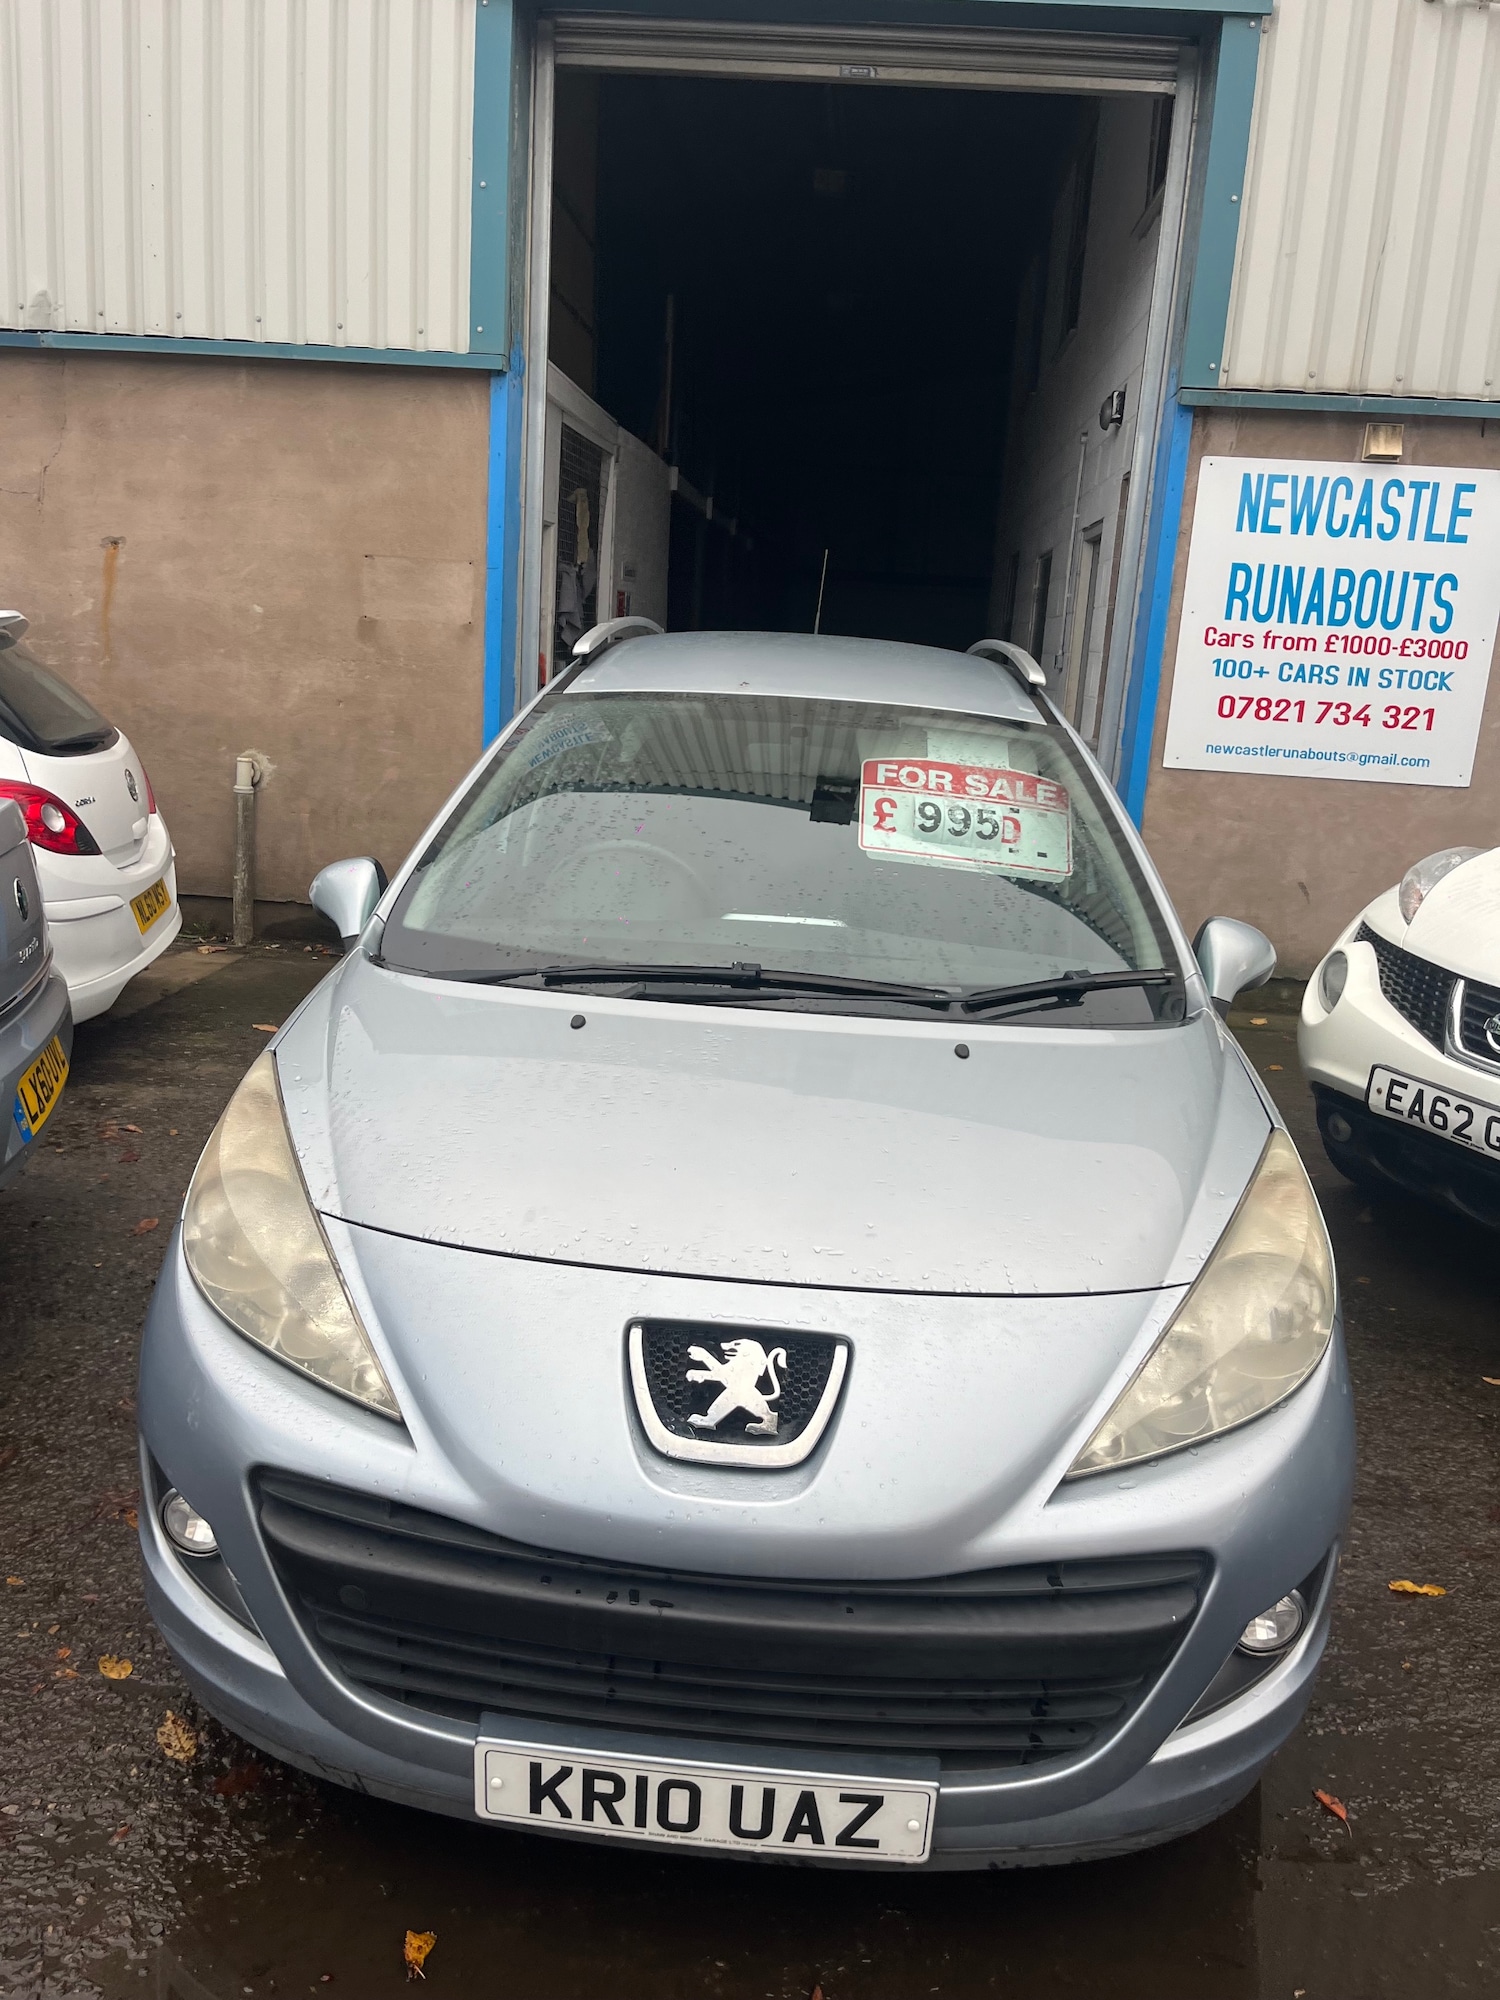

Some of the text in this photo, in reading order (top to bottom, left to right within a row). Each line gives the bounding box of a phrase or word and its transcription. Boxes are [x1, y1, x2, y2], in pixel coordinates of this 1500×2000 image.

[1236, 473, 1476, 544] NEWCASTLE
[1224, 562, 1459, 634] RUNABOUTS
[1204, 626, 1468, 660] Cars from £1000-£3000
[1212, 658, 1454, 691] 100+ CARS IN STOCK
[1217, 695, 1435, 731] 07821 734 321
[1206, 743, 1430, 768] newcastlerunabouts@gmail.com
[876, 763, 1058, 806] FOR SALE
[873, 797, 897, 833] £
[918, 801, 1000, 840] 995
[1385, 1078, 1474, 1141] EA62
[529, 1761, 885, 1849] KR10 UAZ
